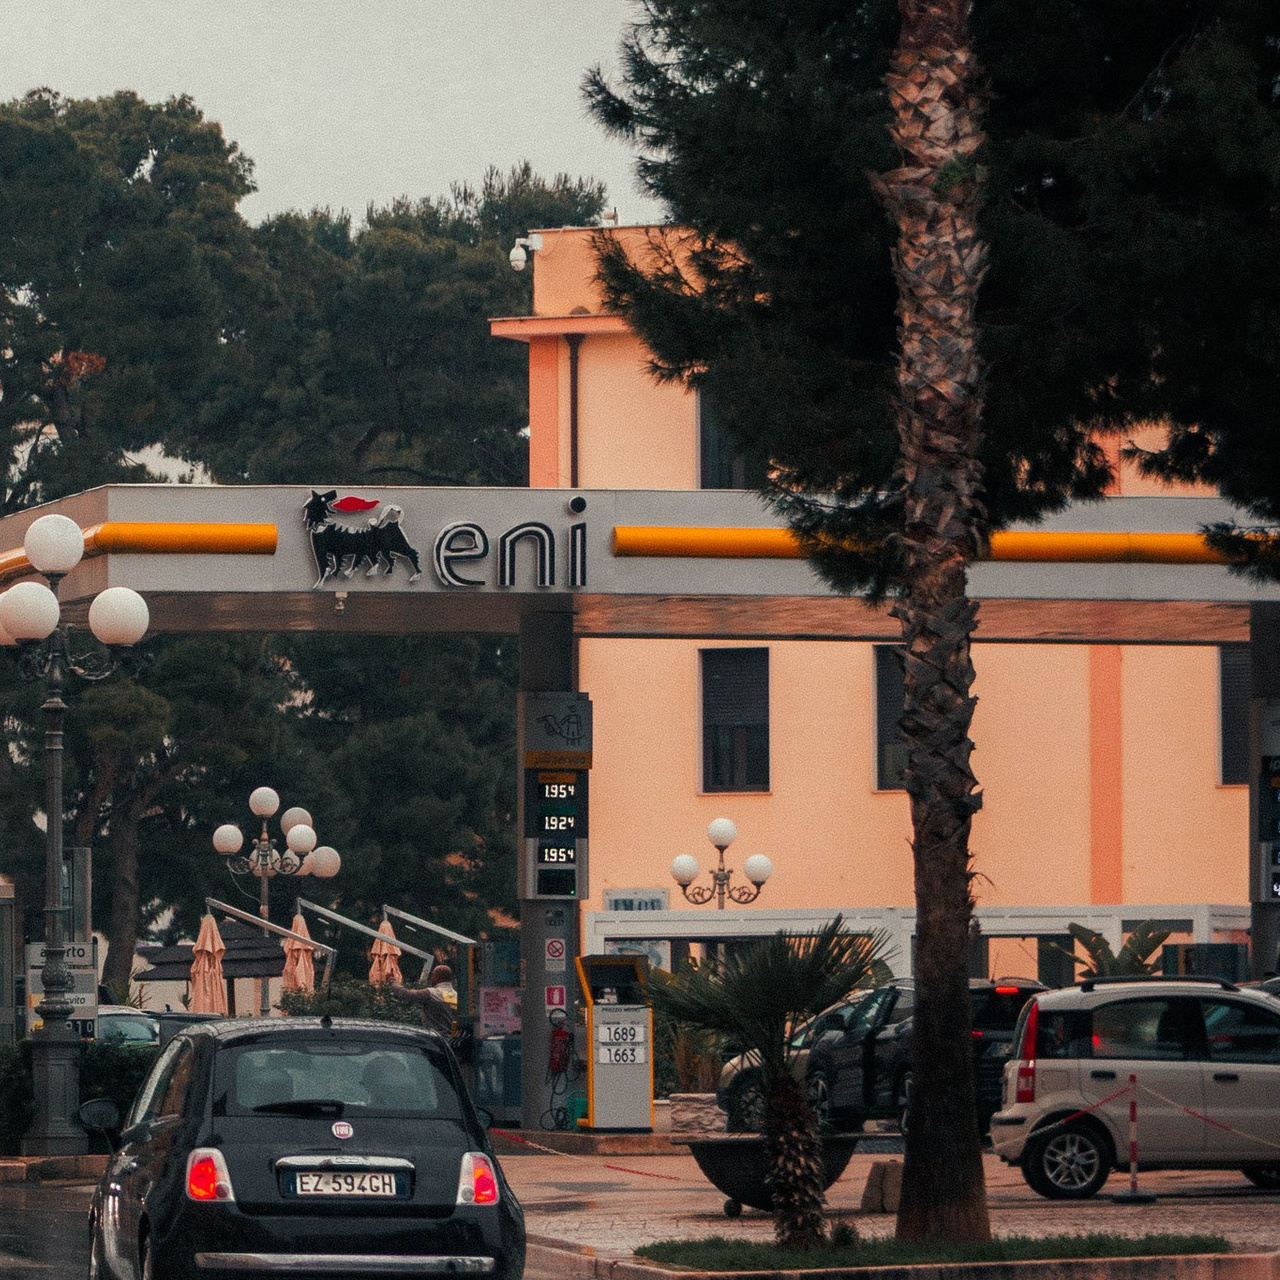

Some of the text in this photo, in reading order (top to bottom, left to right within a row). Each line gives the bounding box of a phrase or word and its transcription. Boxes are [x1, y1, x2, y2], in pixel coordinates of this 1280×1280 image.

[433, 496, 587, 587] eni
[40, 946, 86, 958] arto
[299, 1174, 394, 1194] EZ 594GH
